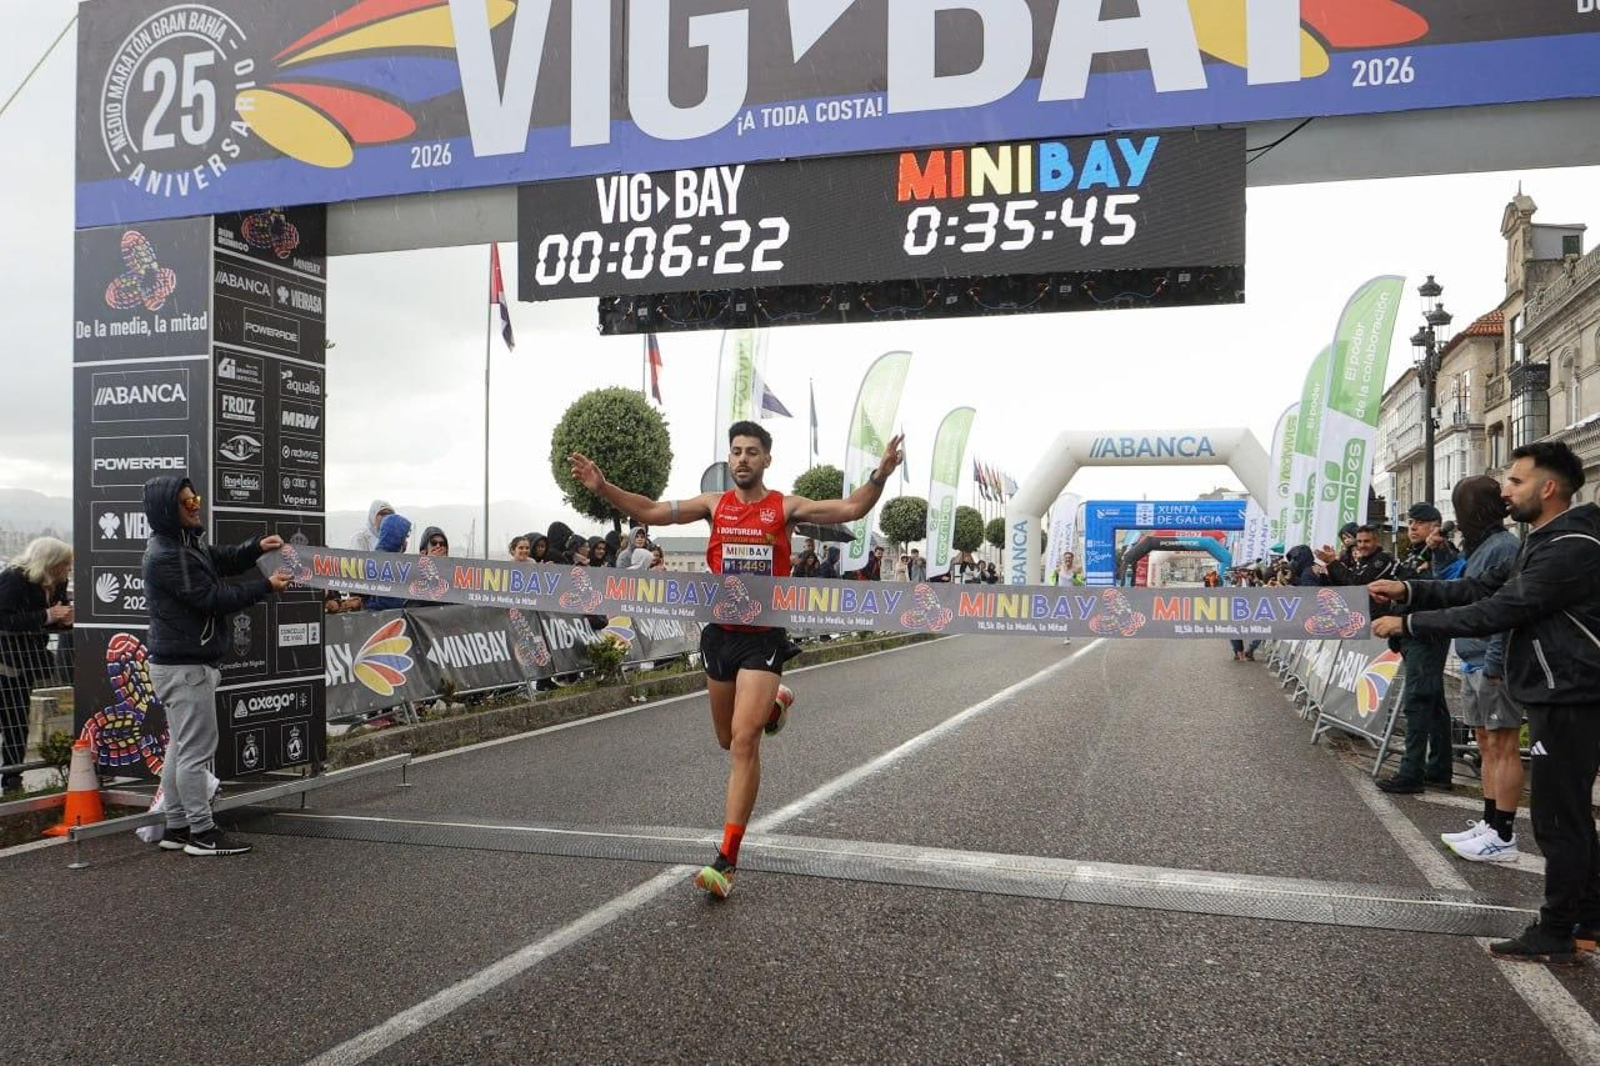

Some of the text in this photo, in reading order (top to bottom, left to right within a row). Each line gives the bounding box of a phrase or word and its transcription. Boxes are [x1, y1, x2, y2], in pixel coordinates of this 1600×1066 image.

[106, 103, 128, 152] MEDIO
[151, 11, 186, 40] GRAN
[1352, 55, 1415, 87] 2026
[142, 50, 216, 151] 25
[761, 105, 809, 127] TODA
[815, 97, 883, 123] COSTA!
[129, 58, 256, 197] ANIVERSARIO
[410, 143, 452, 169] 2026
[897, 135, 1160, 201] MINIBAY
[596, 165, 746, 224] VIG BAY
[903, 194, 1140, 256] 0:35:45
[535, 216, 790, 286] 00:06:22
[76, 311, 208, 339] De la media, la mitad
[1345, 320, 1369, 381] El poder
[103, 383, 187, 405] ABANCA
[286, 378, 320, 396] aqualia
[1357, 385, 1370, 402] la
[222, 394, 256, 416] FROIZ
[282, 411, 320, 430] MRW
[1100, 436, 1215, 458] ABANCA
[94, 457, 187, 471] POWERADE
[1157, 515, 1223, 525] DE GALICIA
[1158, 505, 1198, 514] XUNTA
[313, 554, 412, 581] MINIBAY
[453, 565, 562, 595] MINIBAY
[605, 575, 719, 607] MINIBAY
[771, 584, 904, 615] MINIBAY
[958, 591, 1097, 620] MINIBAY
[1152, 596, 1302, 622] MINIBAY
[432, 630, 511, 669] MINIBAY
